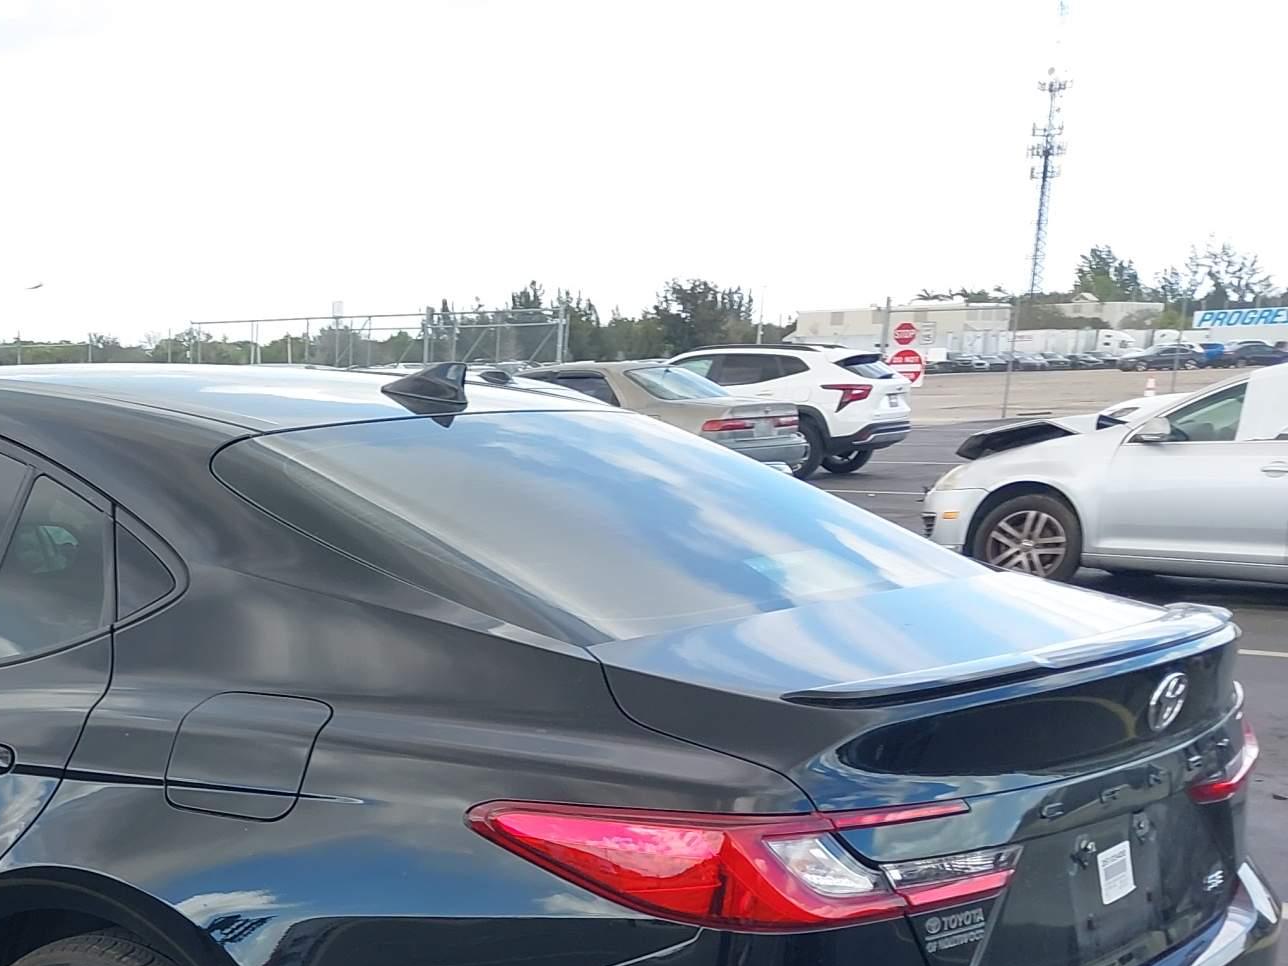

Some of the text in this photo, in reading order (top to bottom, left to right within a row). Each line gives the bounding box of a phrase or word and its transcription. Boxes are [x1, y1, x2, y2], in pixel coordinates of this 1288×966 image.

[1196, 308, 1288, 327] PROGRE
[894, 329, 916, 339] STOP
[942, 907, 985, 931] TOYOTA
